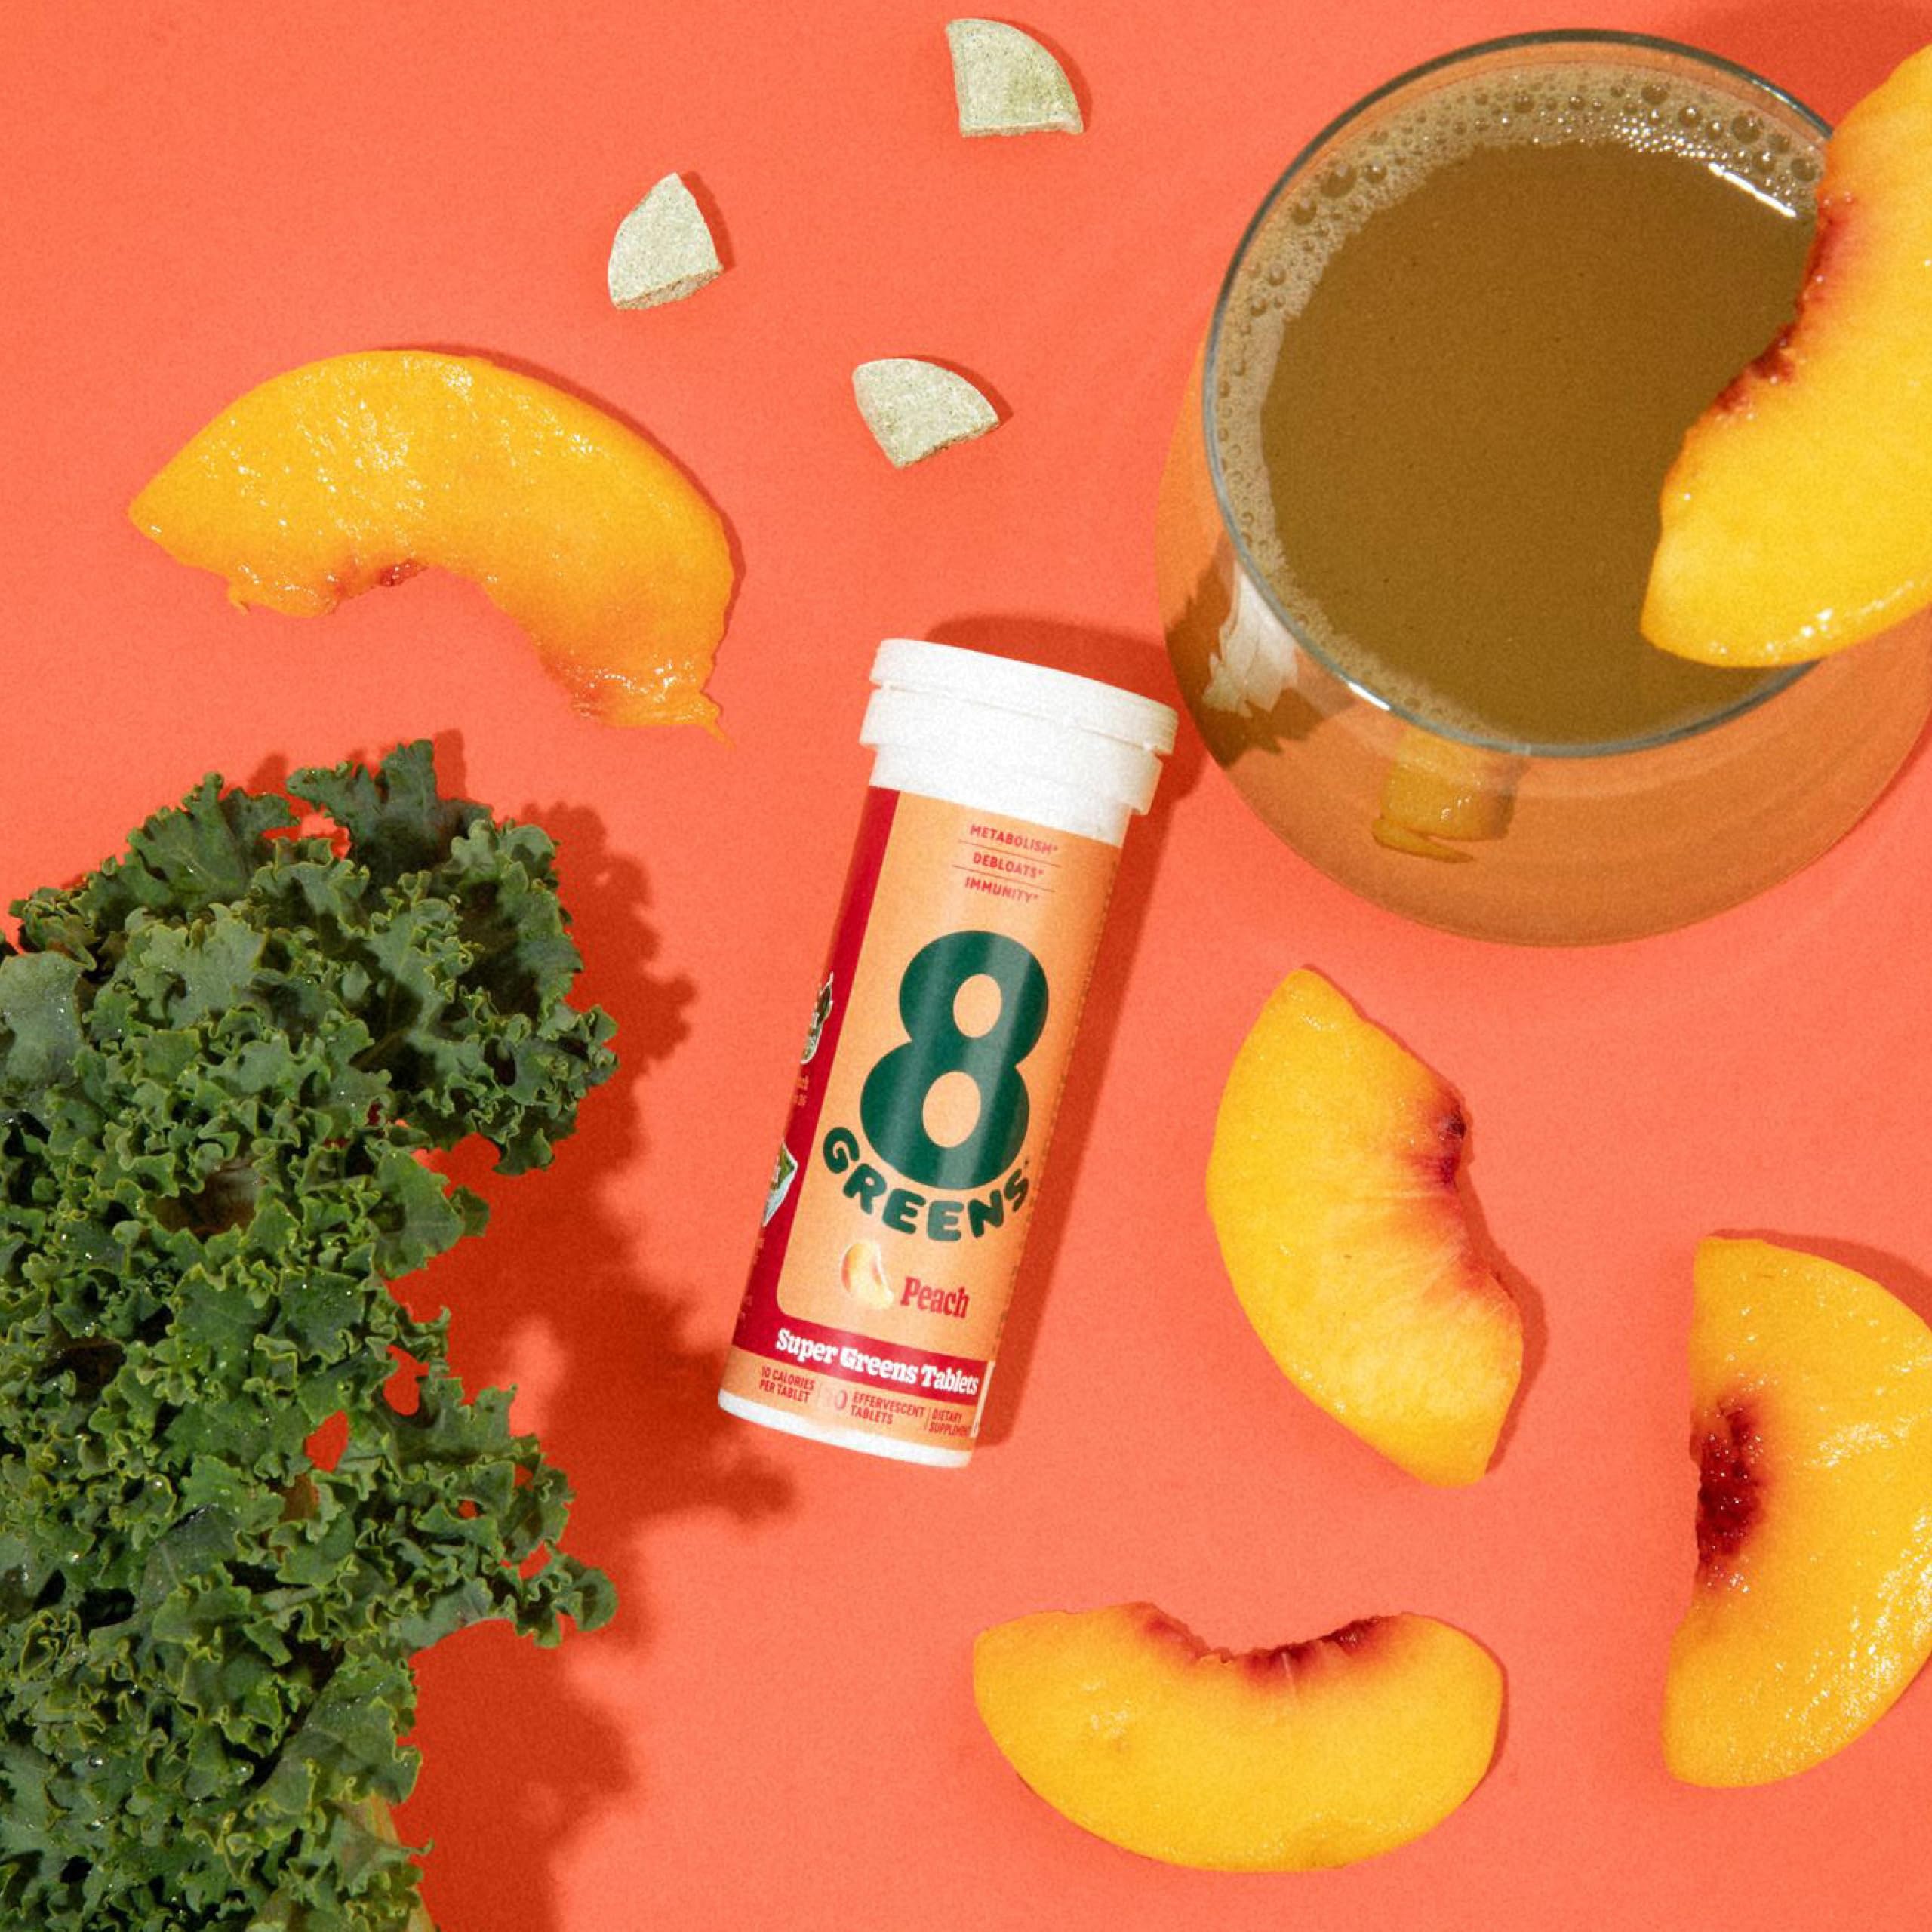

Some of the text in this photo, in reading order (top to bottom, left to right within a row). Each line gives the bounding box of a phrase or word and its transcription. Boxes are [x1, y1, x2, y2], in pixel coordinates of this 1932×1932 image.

[860, 931, 1048, 1190] 8
[823, 1127, 1029, 1241] GREENS
[900, 1277, 970, 1318] Peach
[776, 1328, 979, 1395] Super Greens Tablets
[759, 1379, 811, 1403] PER TABLET
[761, 1366, 815, 1391] 10 CALORIES
[850, 1404, 894, 1425] TABLETS
[853, 1392, 927, 1418] EFFERVESCENT
[931, 1408, 963, 1423] DIETARY
